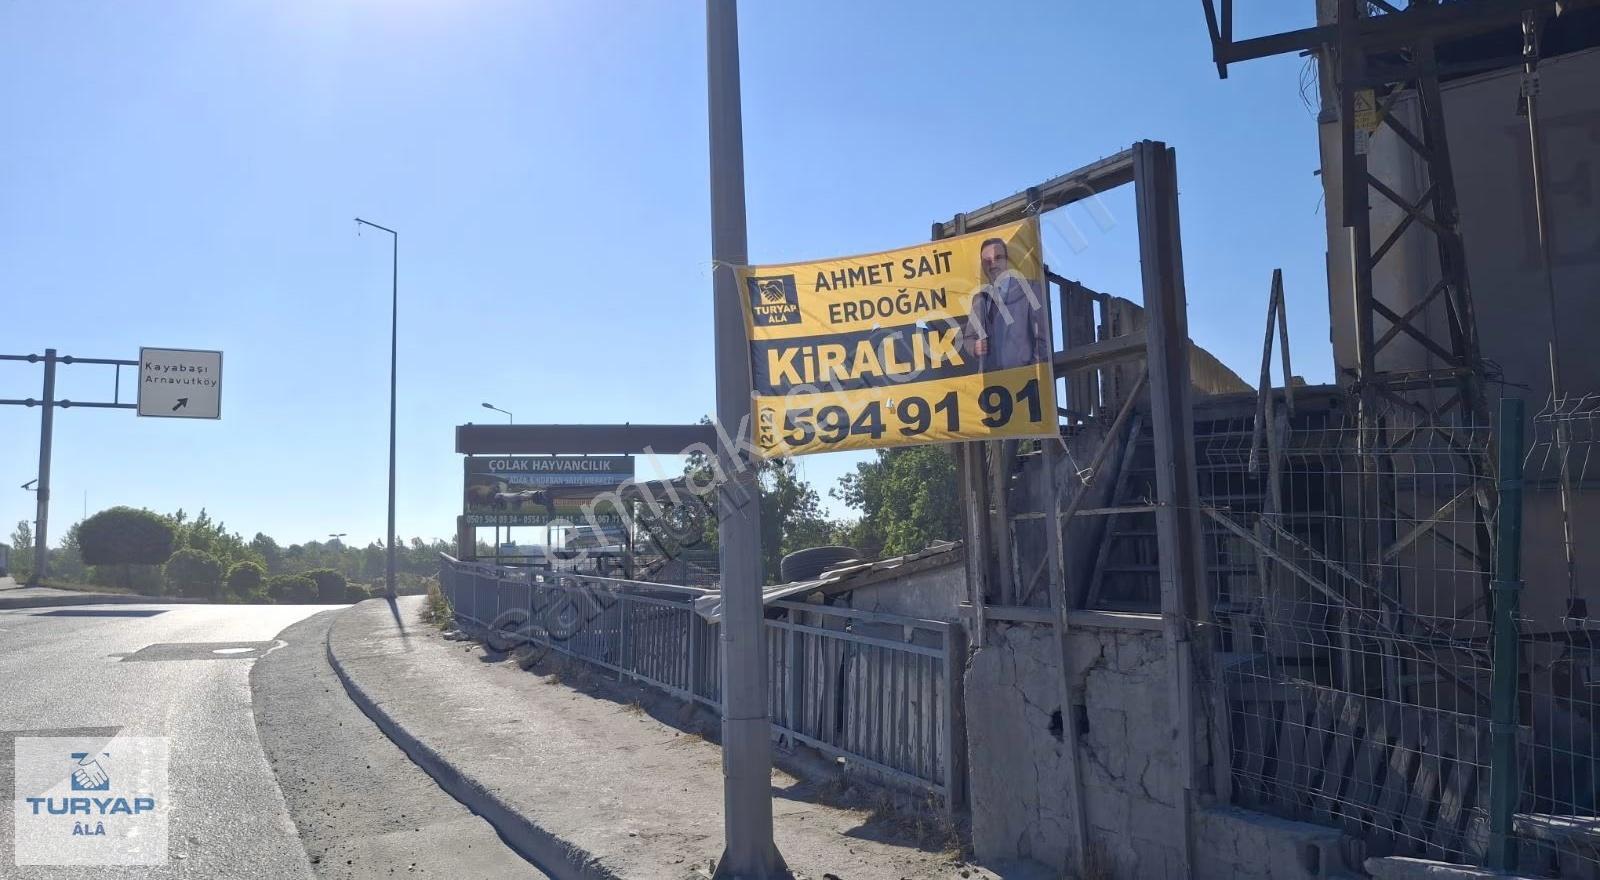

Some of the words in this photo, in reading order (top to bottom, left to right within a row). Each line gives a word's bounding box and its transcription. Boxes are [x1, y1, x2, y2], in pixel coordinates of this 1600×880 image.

[815, 262, 895, 293] AHMET
[902, 250, 953, 280] SAİT
[754, 304, 797, 316] TURYAP
[828, 287, 947, 324] ERDOĞAN
[145, 361, 208, 373] Kayabaşı
[145, 375, 217, 388] Arnavutköy
[759, 407, 776, 450] (212)
[783, 400, 887, 447] 594
[896, 390, 961, 437] 91
[977, 379, 1043, 429] 91
[488, 459, 528, 472] ÇOLAK
[532, 459, 611, 471] HAYVANCILIK
